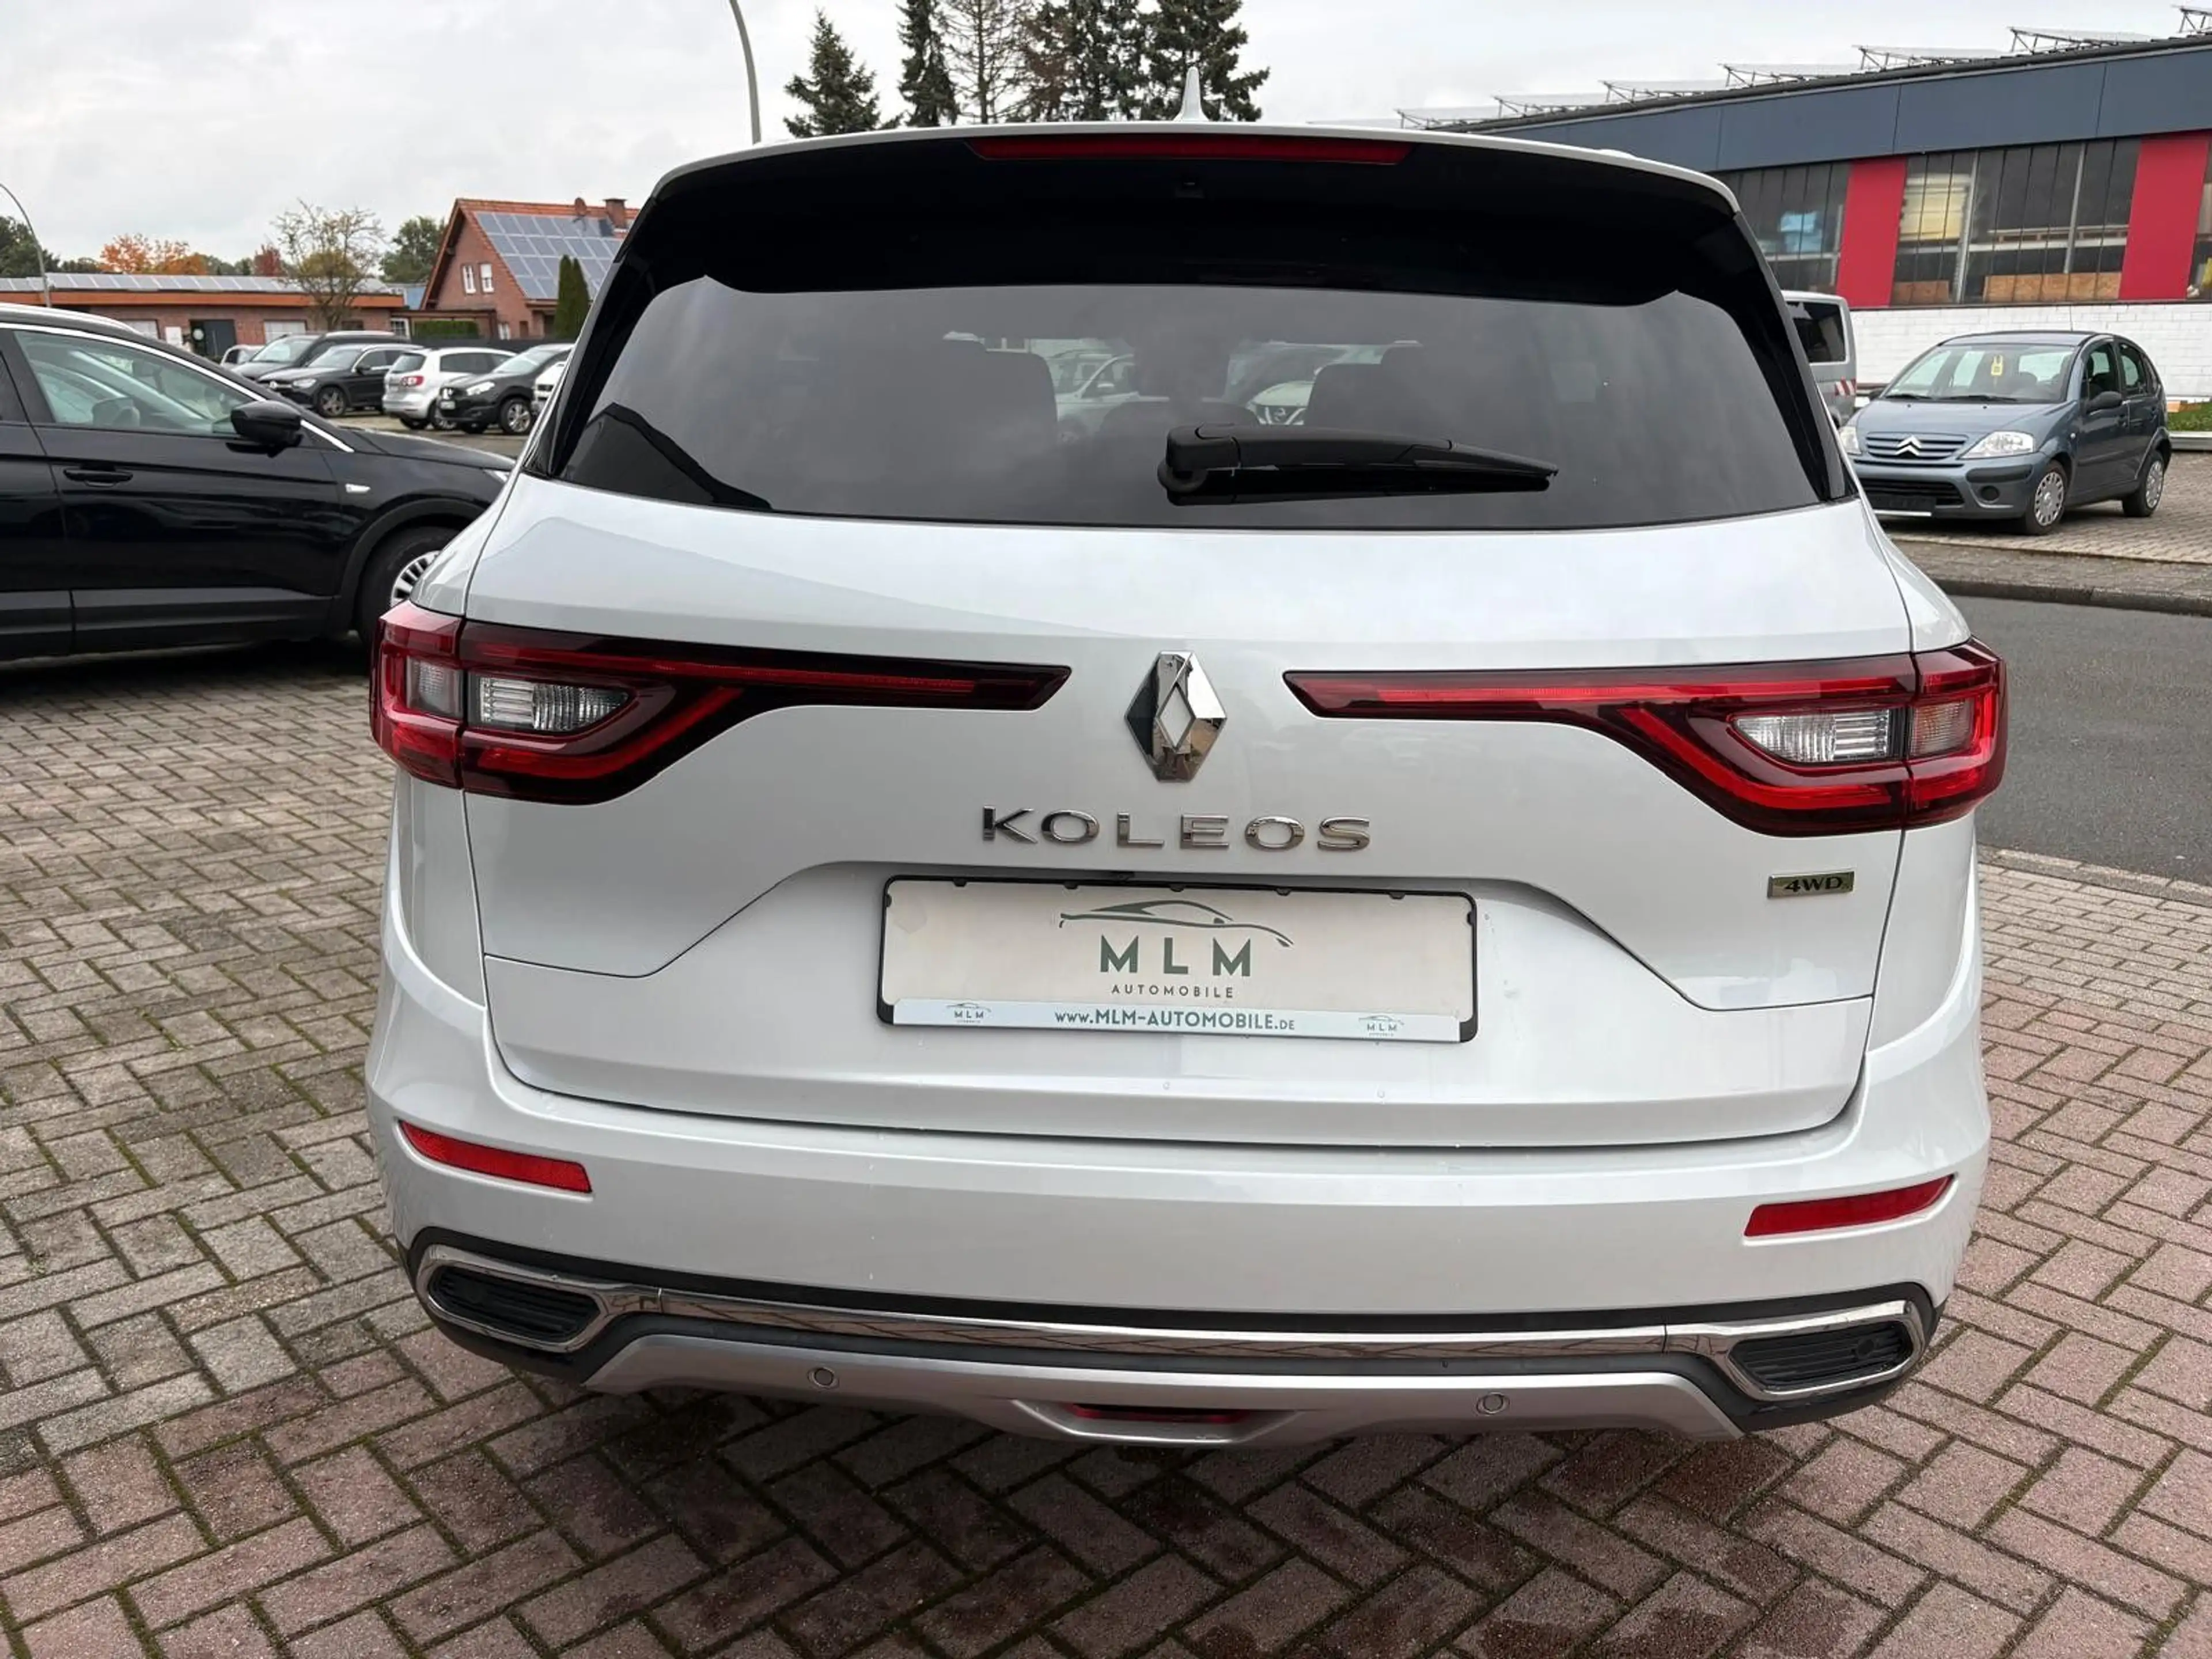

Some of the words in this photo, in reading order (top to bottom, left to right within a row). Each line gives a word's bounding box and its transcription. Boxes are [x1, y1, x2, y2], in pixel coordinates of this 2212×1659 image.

[983, 806, 1370, 850] KOLEOS
[1784, 876, 1843, 892] 4WD
[1111, 984, 1233, 998] AUTOMOBILE
